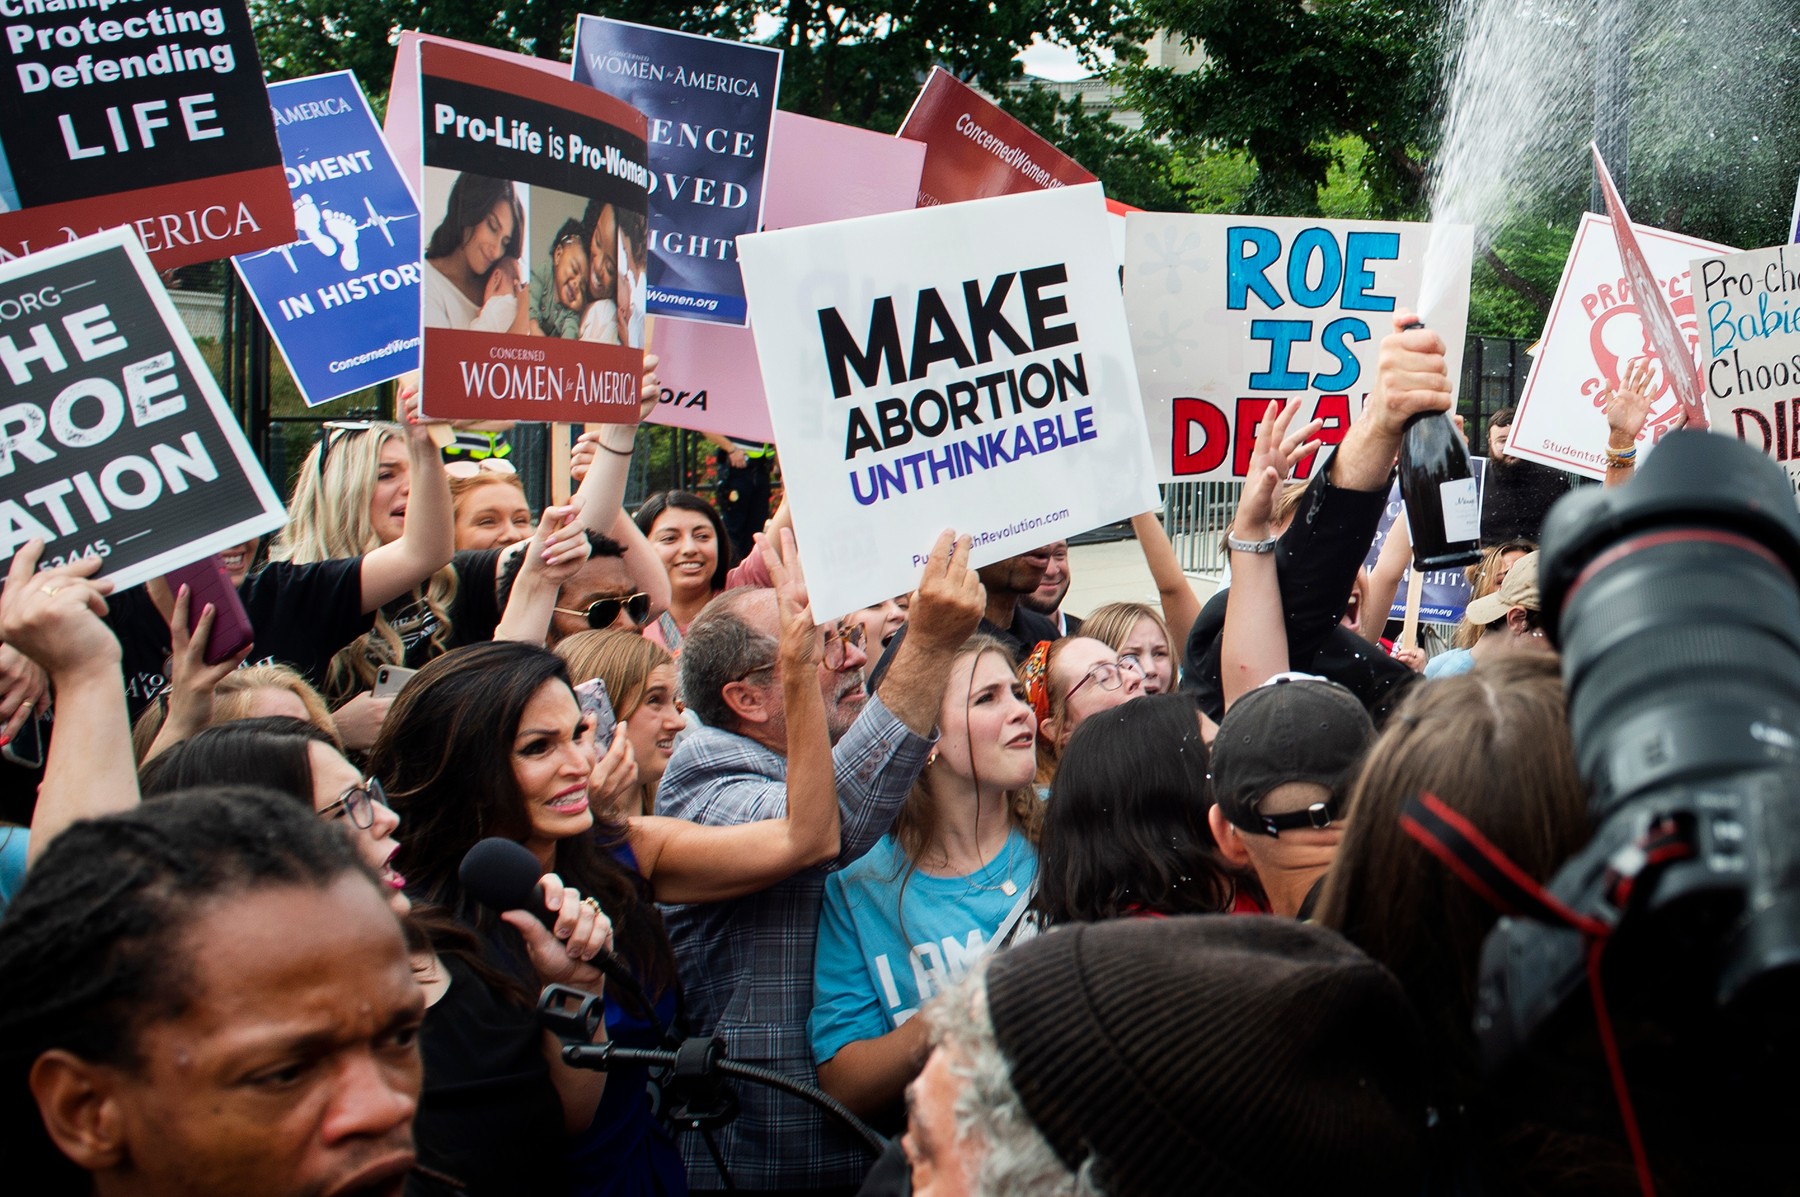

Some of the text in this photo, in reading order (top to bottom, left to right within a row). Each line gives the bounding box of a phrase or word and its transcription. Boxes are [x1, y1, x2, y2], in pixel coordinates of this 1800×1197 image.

[6, 6, 226, 54] Protecting
[16, 43, 236, 93] Defending
[589, 53, 665, 82] WOMEN
[672, 65, 760, 98] AMERICA
[58, 92, 225, 160] LIFE
[434, 103, 647, 189] Pro-Life is Pro-Woman
[955, 113, 1066, 189] ConcernedWomen.or
[1226, 226, 1401, 312] ROE
[279, 293, 316, 321] IN
[818, 262, 1079, 399] MAKE
[459, 360, 564, 401] WOMEN
[574, 362, 636, 406] AMERICA
[490, 346, 545, 362] CONCERNED
[1248, 317, 1372, 391] IS
[0, 350, 187, 477] ROE
[845, 352, 1090, 461] ABORTION
[1171, 394, 1370, 479] DEA
[849, 406, 1098, 506] UNTHINKABLE
[875, 953, 902, 1009] I
